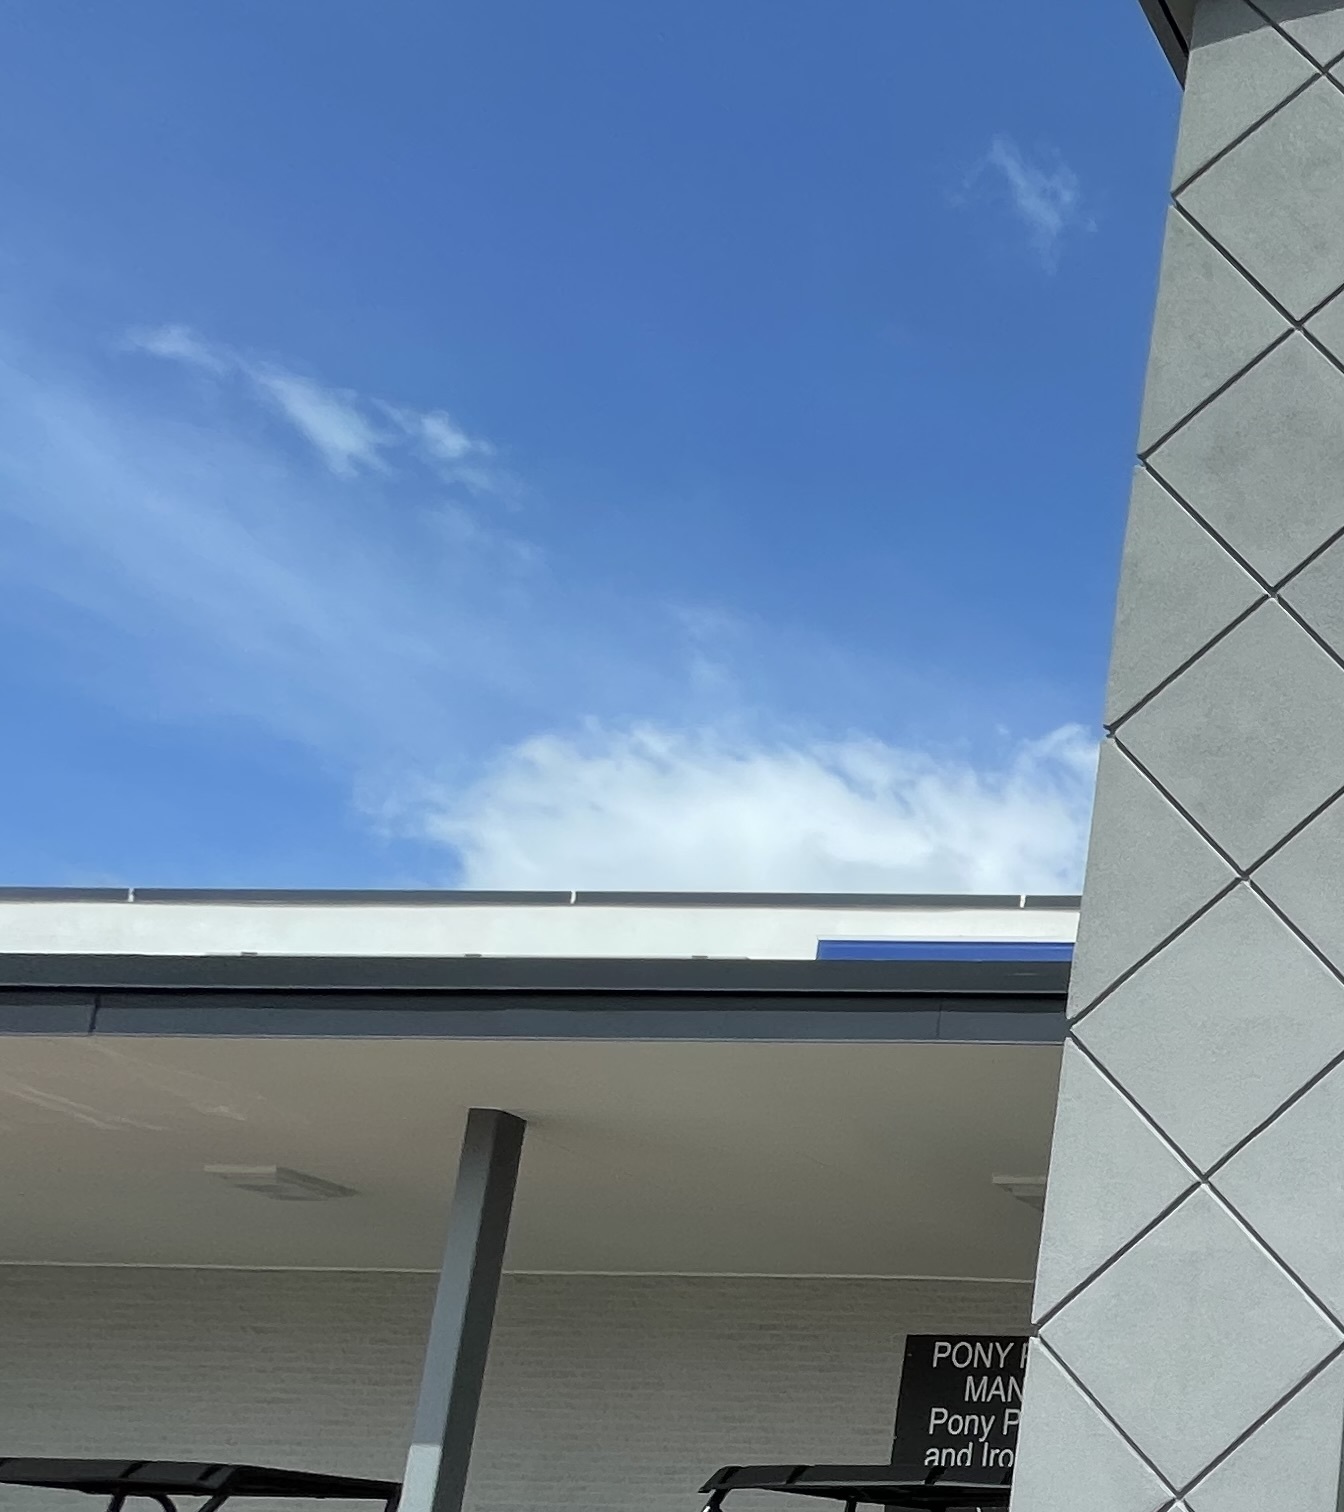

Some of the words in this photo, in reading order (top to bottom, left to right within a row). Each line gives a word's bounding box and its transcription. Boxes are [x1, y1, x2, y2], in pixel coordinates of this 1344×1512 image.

[932, 1341, 1014, 1368] PONY
[929, 1407, 996, 1442] Pony
[924, 1442, 973, 1467] and
